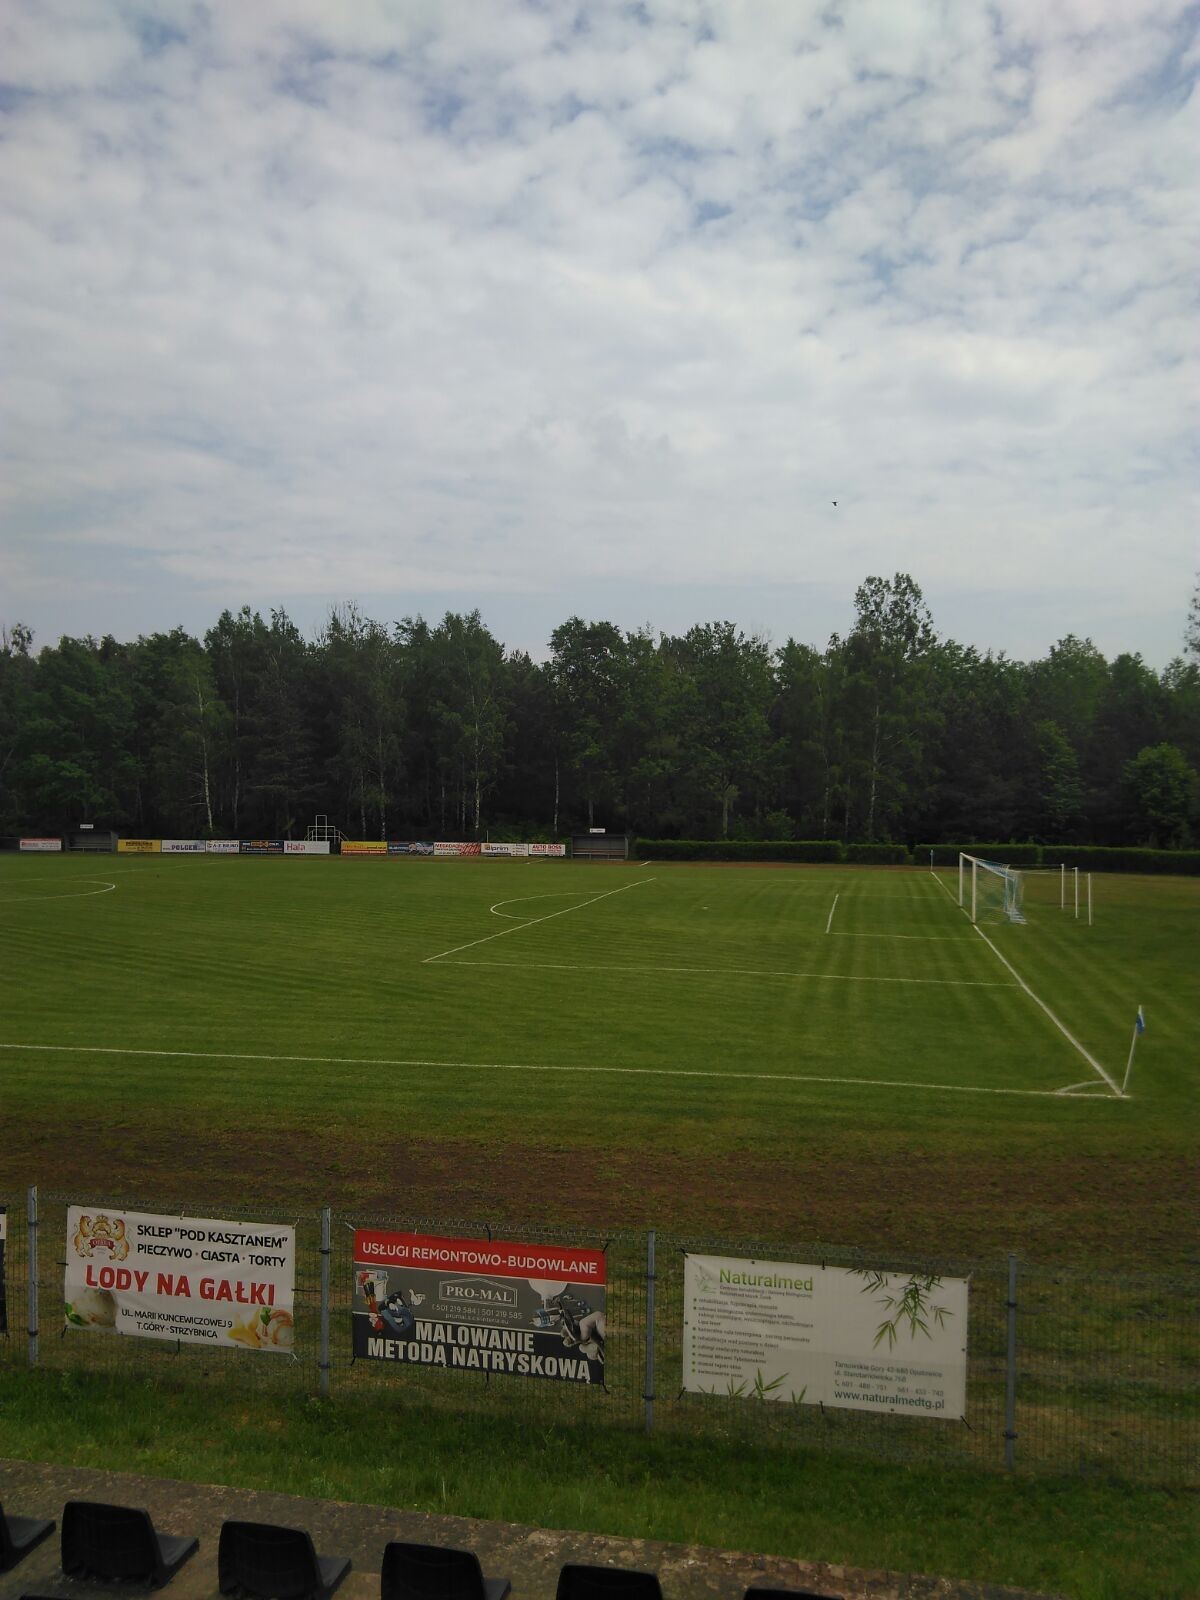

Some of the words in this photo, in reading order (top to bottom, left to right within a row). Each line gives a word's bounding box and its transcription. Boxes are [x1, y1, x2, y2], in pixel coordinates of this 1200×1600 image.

[286, 843, 306, 851] Hala
[137, 1224, 172, 1238] SKLEP
[137, 1244, 192, 1259] PIECZYWO
[200, 1250, 240, 1264] CIASTA
[249, 1254, 286, 1268] TORTY
[362, 1241, 410, 1258] USŁUGI
[412, 1247, 598, 1274] REMONTOWO-BUDOWLANE
[86, 1264, 150, 1292] LODY
[156, 1273, 191, 1298] NA
[200, 1278, 275, 1306] GAŁKI
[719, 1268, 814, 1291] Naturalmed
[446, 1286, 512, 1302] PRO-MAL
[134, 1310, 157, 1320] MARII
[158, 1312, 227, 1328] KUNCEWICZOWEJ
[228, 1320, 233, 1329] 9
[415, 1321, 535, 1353] MALOWANIE
[367, 1336, 447, 1368] METODĄ
[452, 1346, 590, 1384] NATRYSKOWĄ
[834, 1390, 945, 1410] www.naturalmedtg.pl
